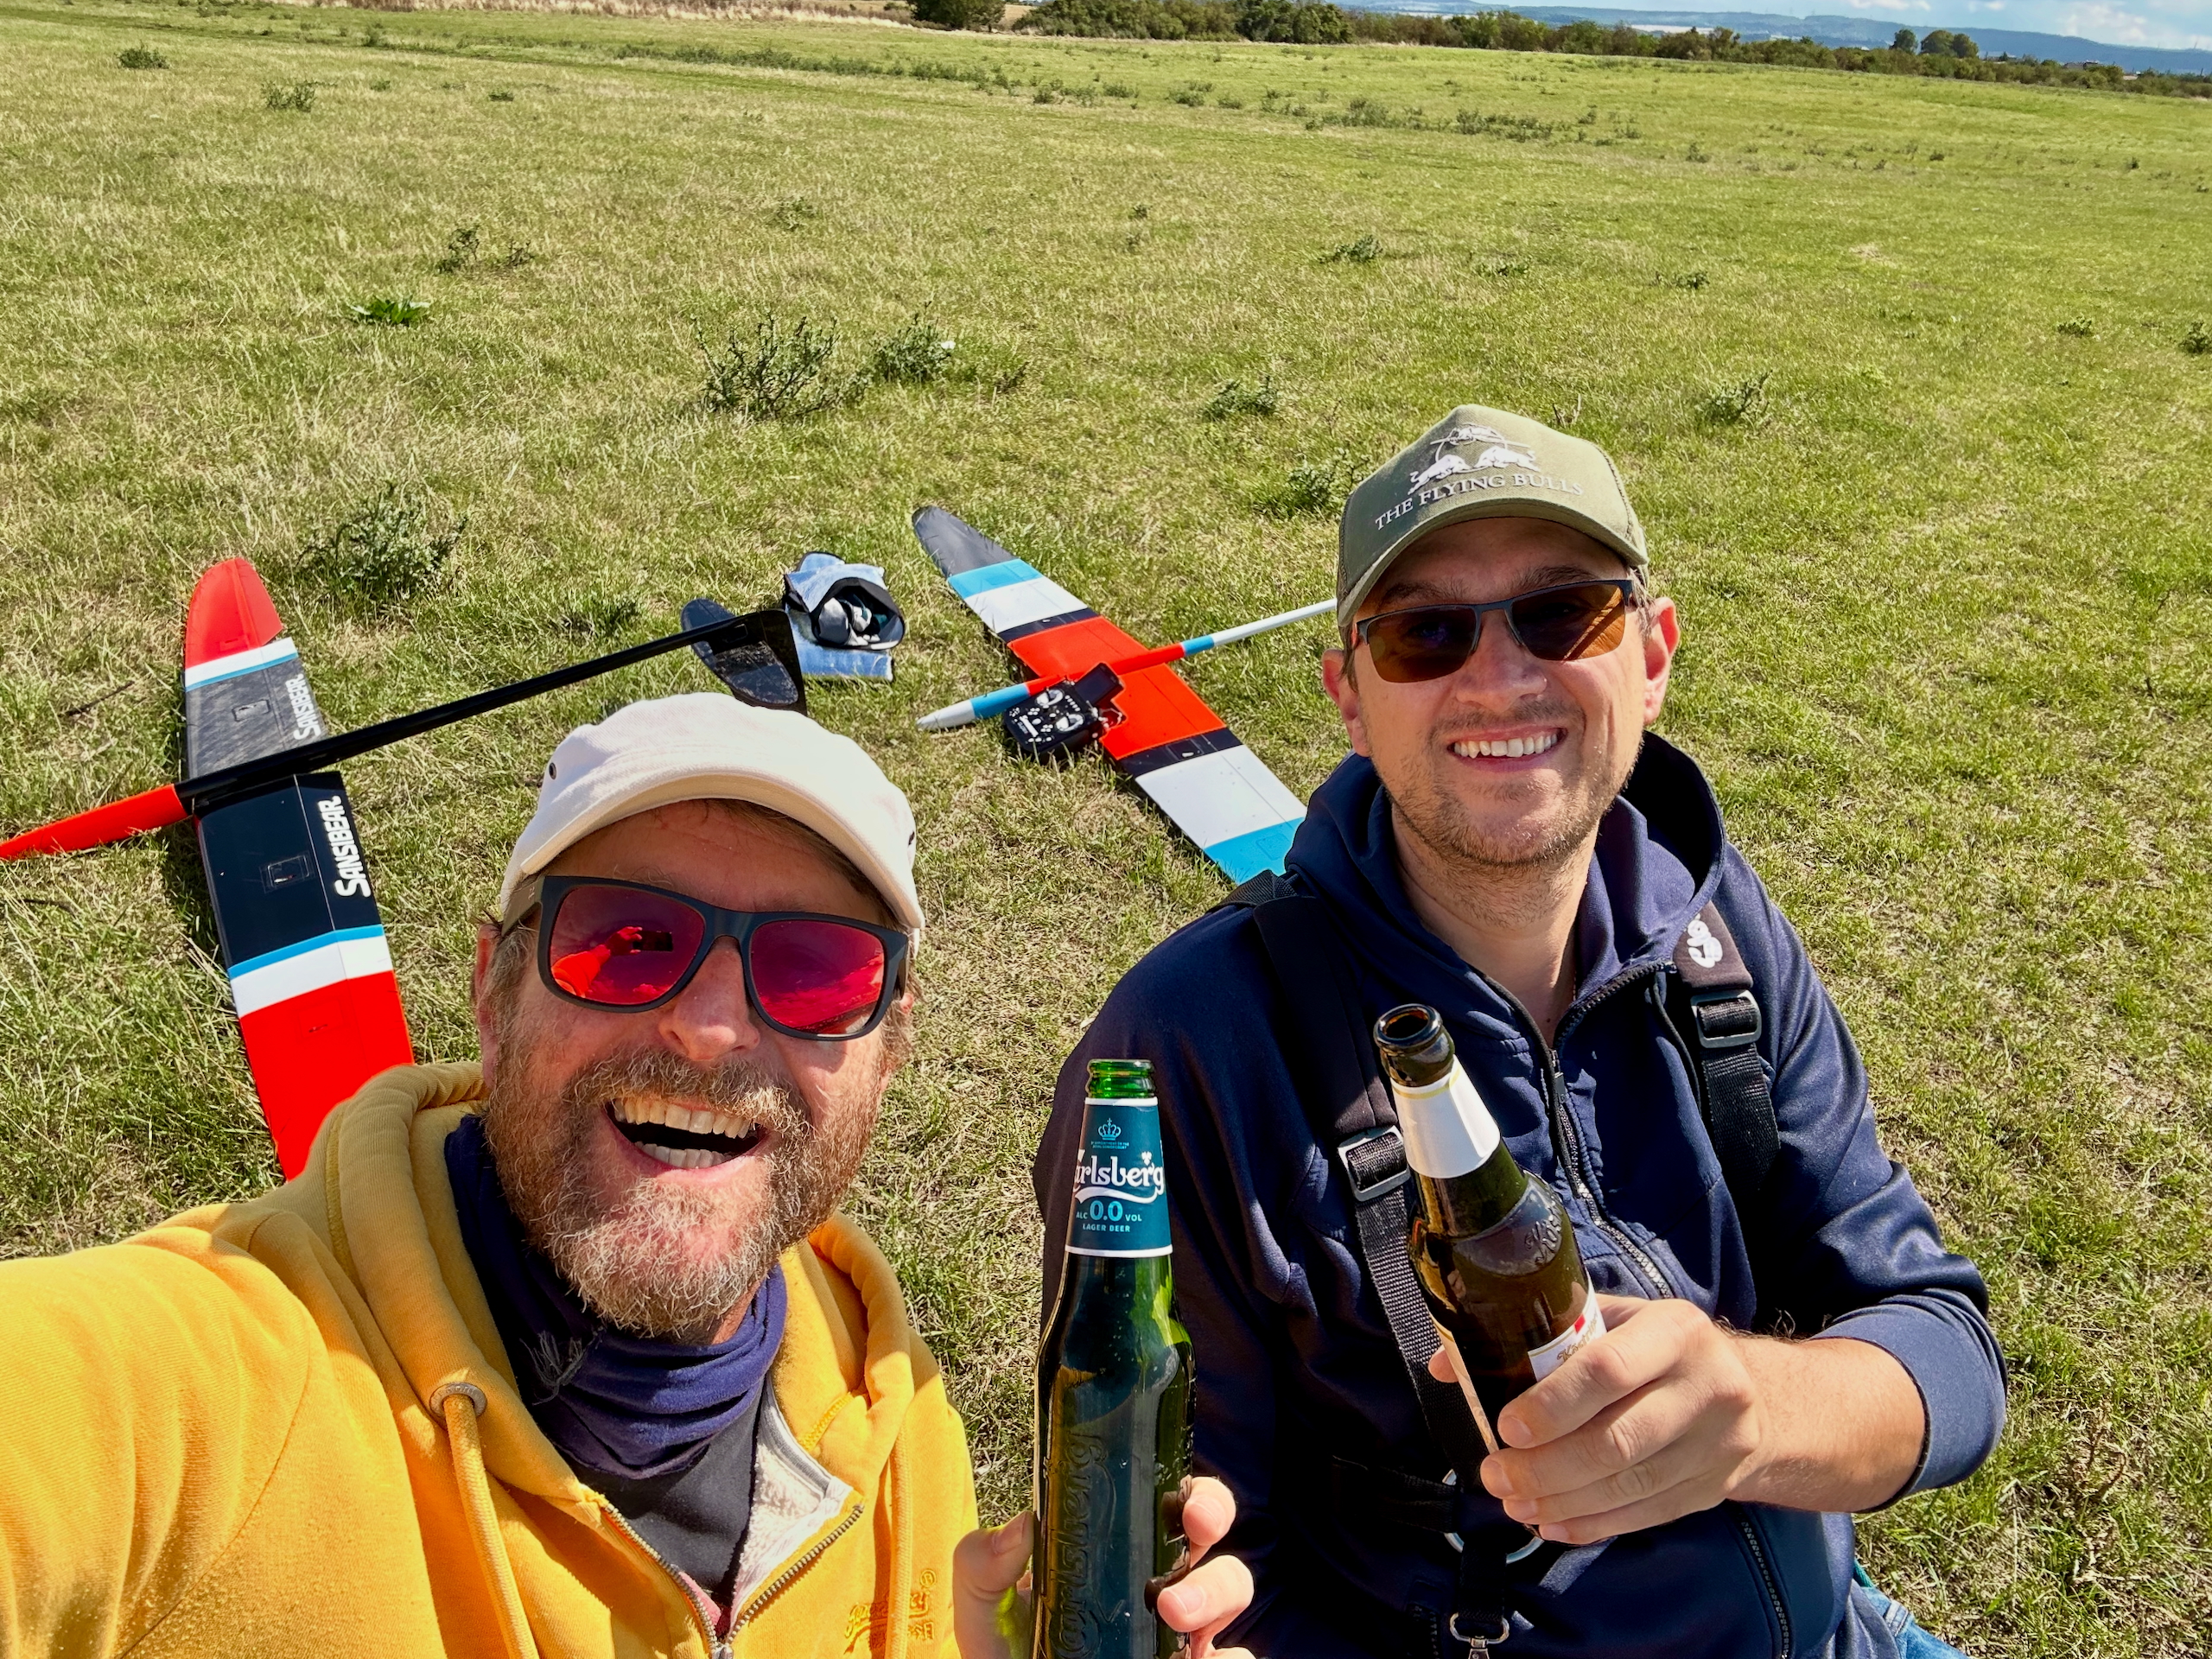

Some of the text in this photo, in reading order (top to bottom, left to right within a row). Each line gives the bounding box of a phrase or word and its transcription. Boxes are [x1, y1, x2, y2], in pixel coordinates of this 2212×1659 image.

[1375, 474, 1584, 531] THE FLYING BULLS
[285, 674, 321, 741] SANSIBEAR
[317, 795, 372, 898] SANSIBEAR
[1076, 1200, 1142, 1223] ALC 0.0 VOL
[1082, 1223, 1131, 1233] LAGER BEER
